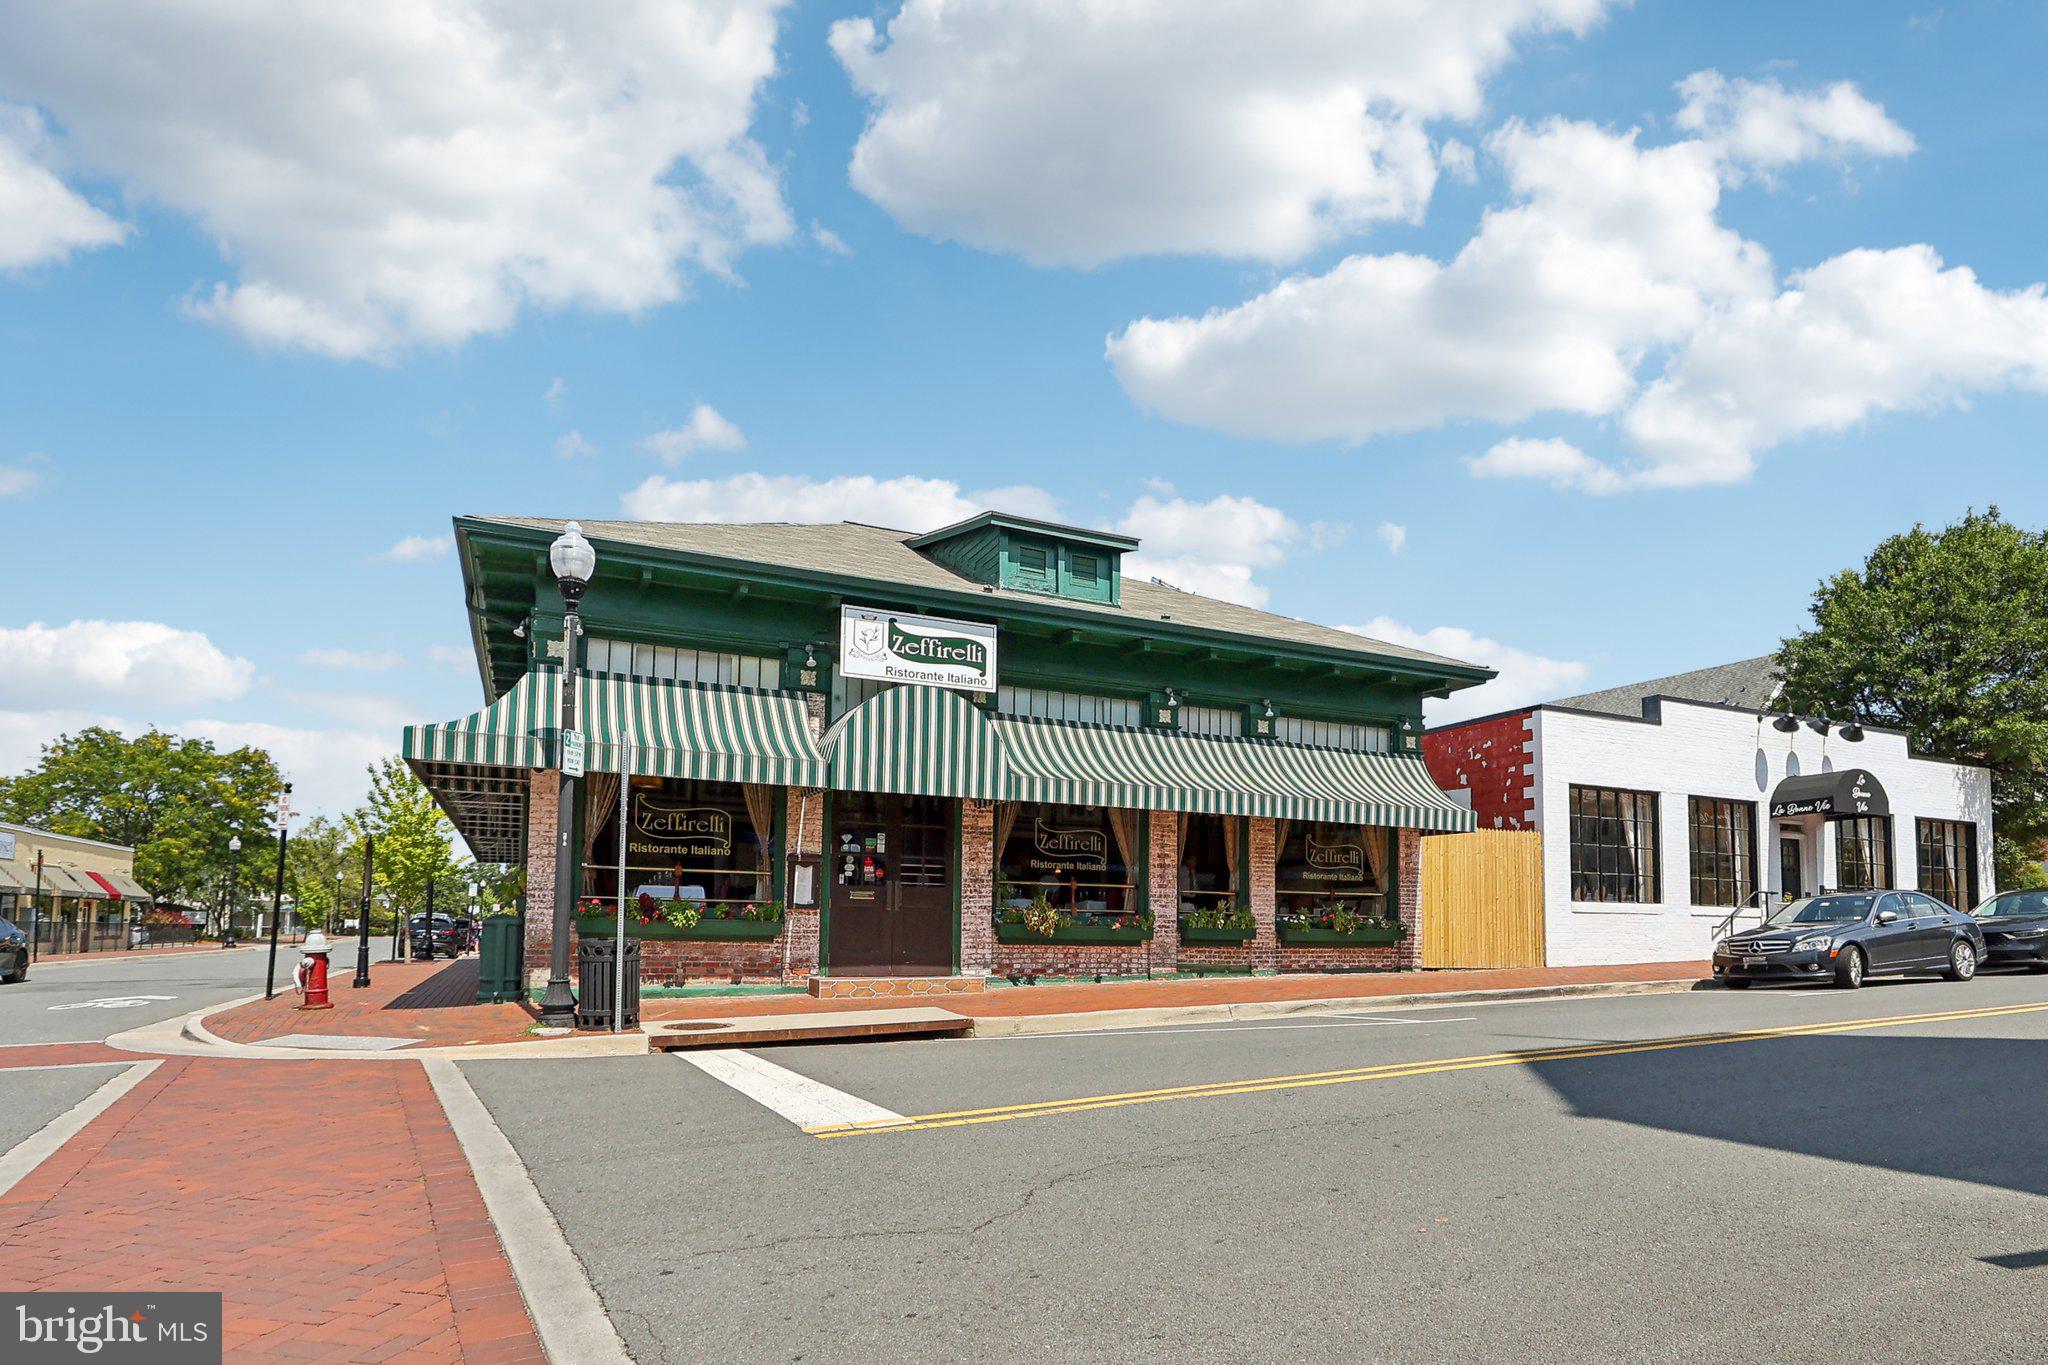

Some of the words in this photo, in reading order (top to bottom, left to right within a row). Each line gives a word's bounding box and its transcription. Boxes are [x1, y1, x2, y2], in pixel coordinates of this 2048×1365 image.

[892, 634, 983, 663] Zeffirelli
[885, 665, 944, 682] Ristorante
[947, 674, 988, 687] Italiano
[1856, 774, 1866, 786] La
[1852, 786, 1872, 799] Bonne
[1772, 804, 1785, 816] La
[1787, 803, 1814, 815] Bonne
[1815, 800, 1832, 812] Vie
[1856, 801, 1869, 813] Vie
[641, 812, 725, 833] Zeffirelli
[1040, 833, 1101, 851] Zeffirelli
[629, 843, 688, 855] Ristorante
[691, 845, 731, 856] Italiano
[1309, 848, 1359, 864] Zeffirelli
[1030, 860, 1075, 870] Ristorante
[1076, 861, 1107, 871] Italiano
[1302, 871, 1339, 881] Ristorante
[1339, 872, 1364, 882] Italiano
